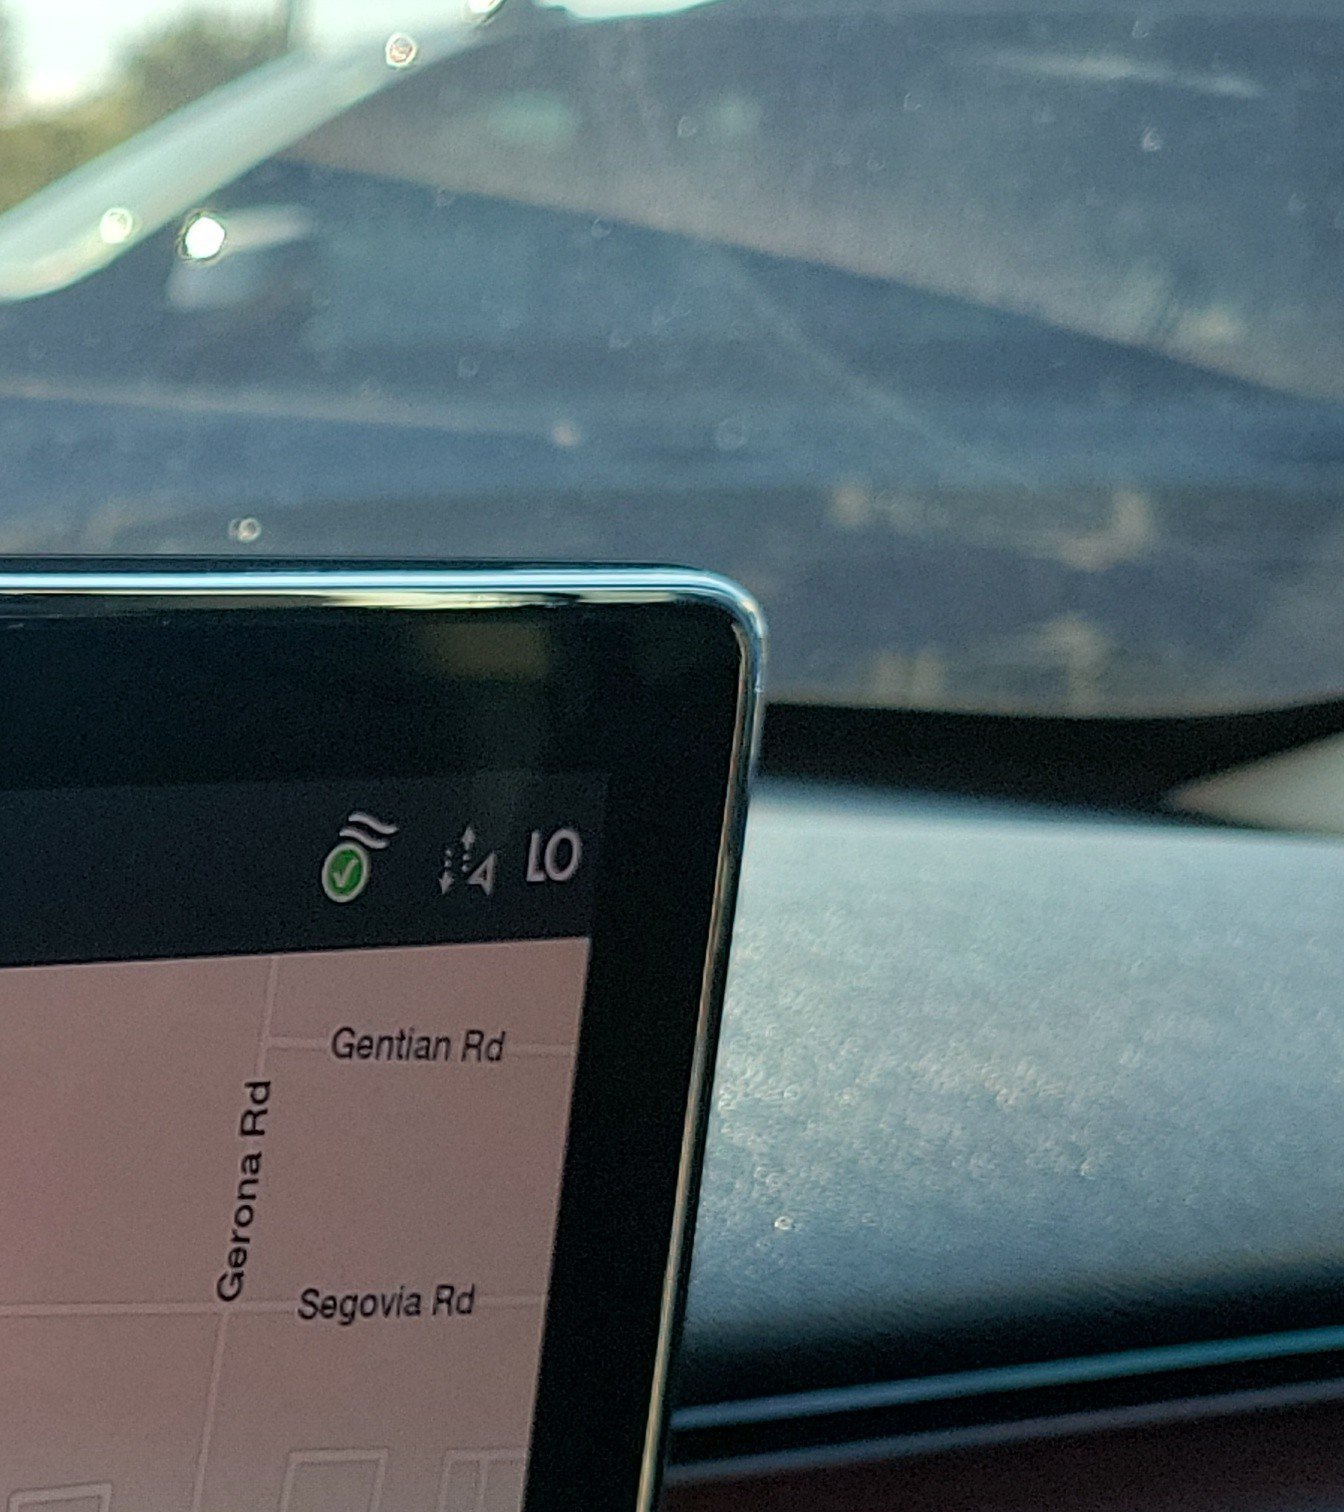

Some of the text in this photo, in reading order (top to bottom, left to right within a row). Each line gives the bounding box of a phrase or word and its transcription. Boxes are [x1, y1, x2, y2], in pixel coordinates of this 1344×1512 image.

[526, 826, 582, 883] LO
[330, 1025, 506, 1063] Gentian Rd
[216, 1080, 272, 1302] Gerona Rd
[296, 1284, 476, 1326] Segovia Rd
